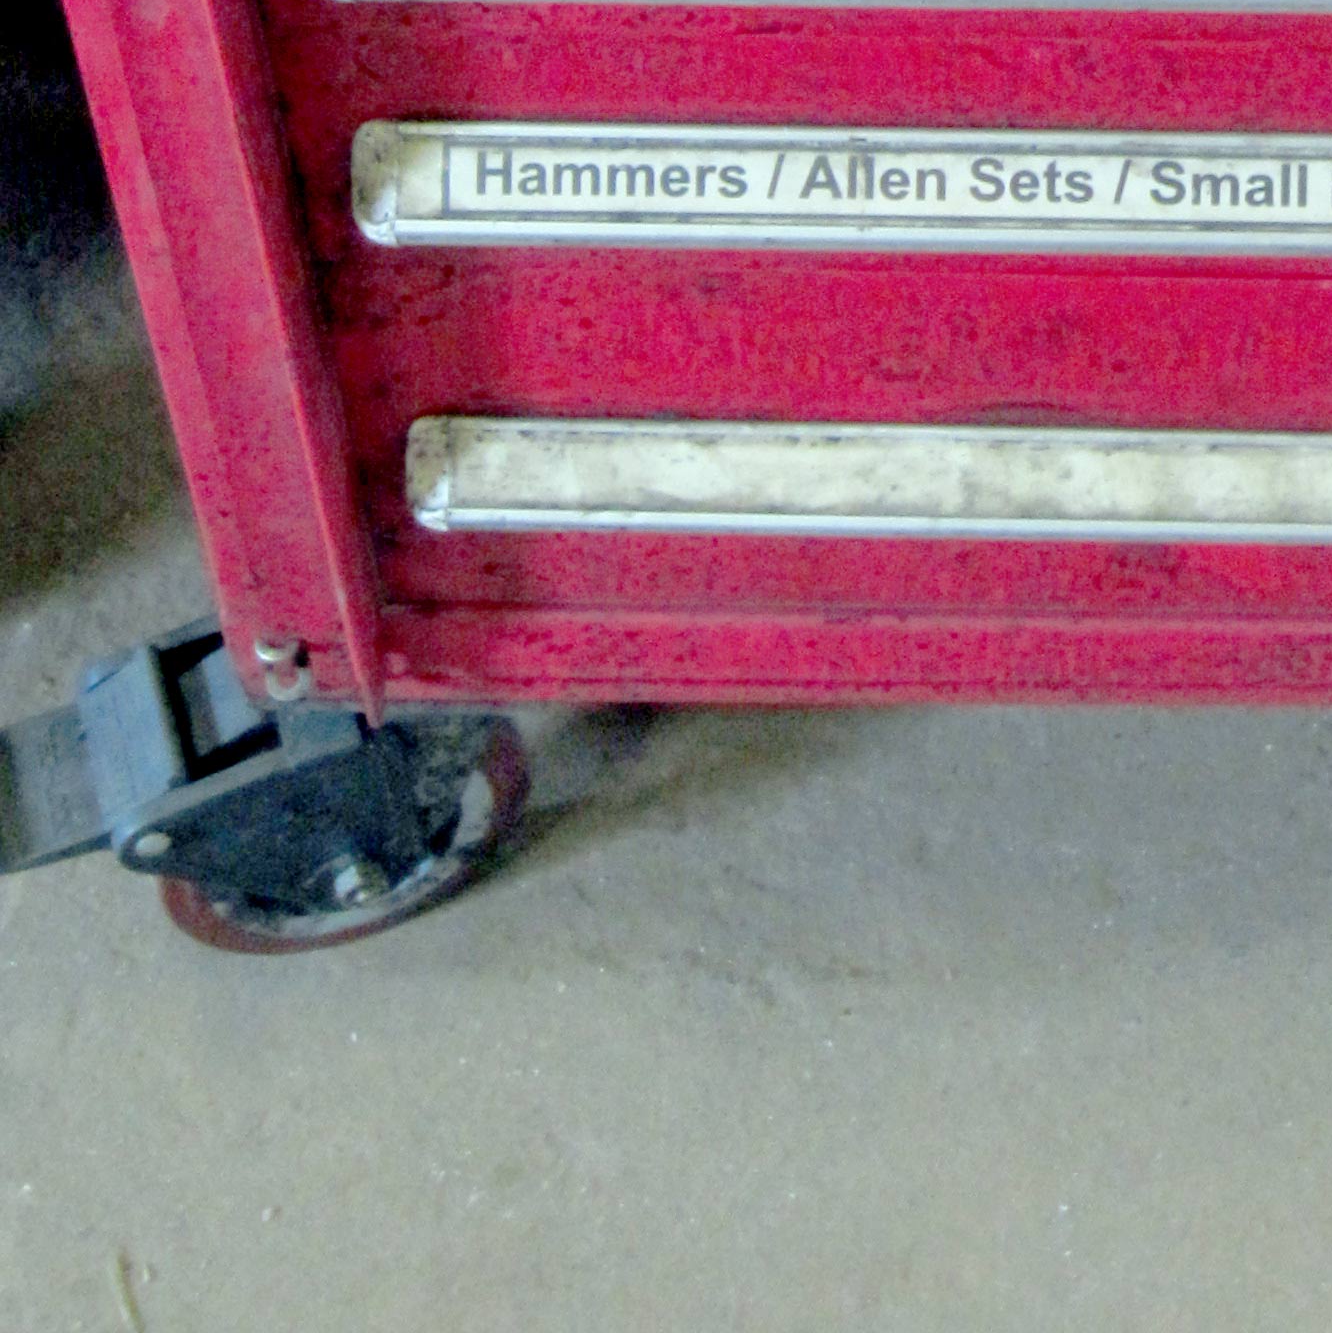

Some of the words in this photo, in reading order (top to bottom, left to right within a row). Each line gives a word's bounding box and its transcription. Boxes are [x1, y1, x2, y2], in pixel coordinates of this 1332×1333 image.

[475, 151, 749, 198] Hammers
[800, 155, 948, 202] Allen
[969, 157, 1094, 204] Sets
[1150, 160, 1308, 209] Small
